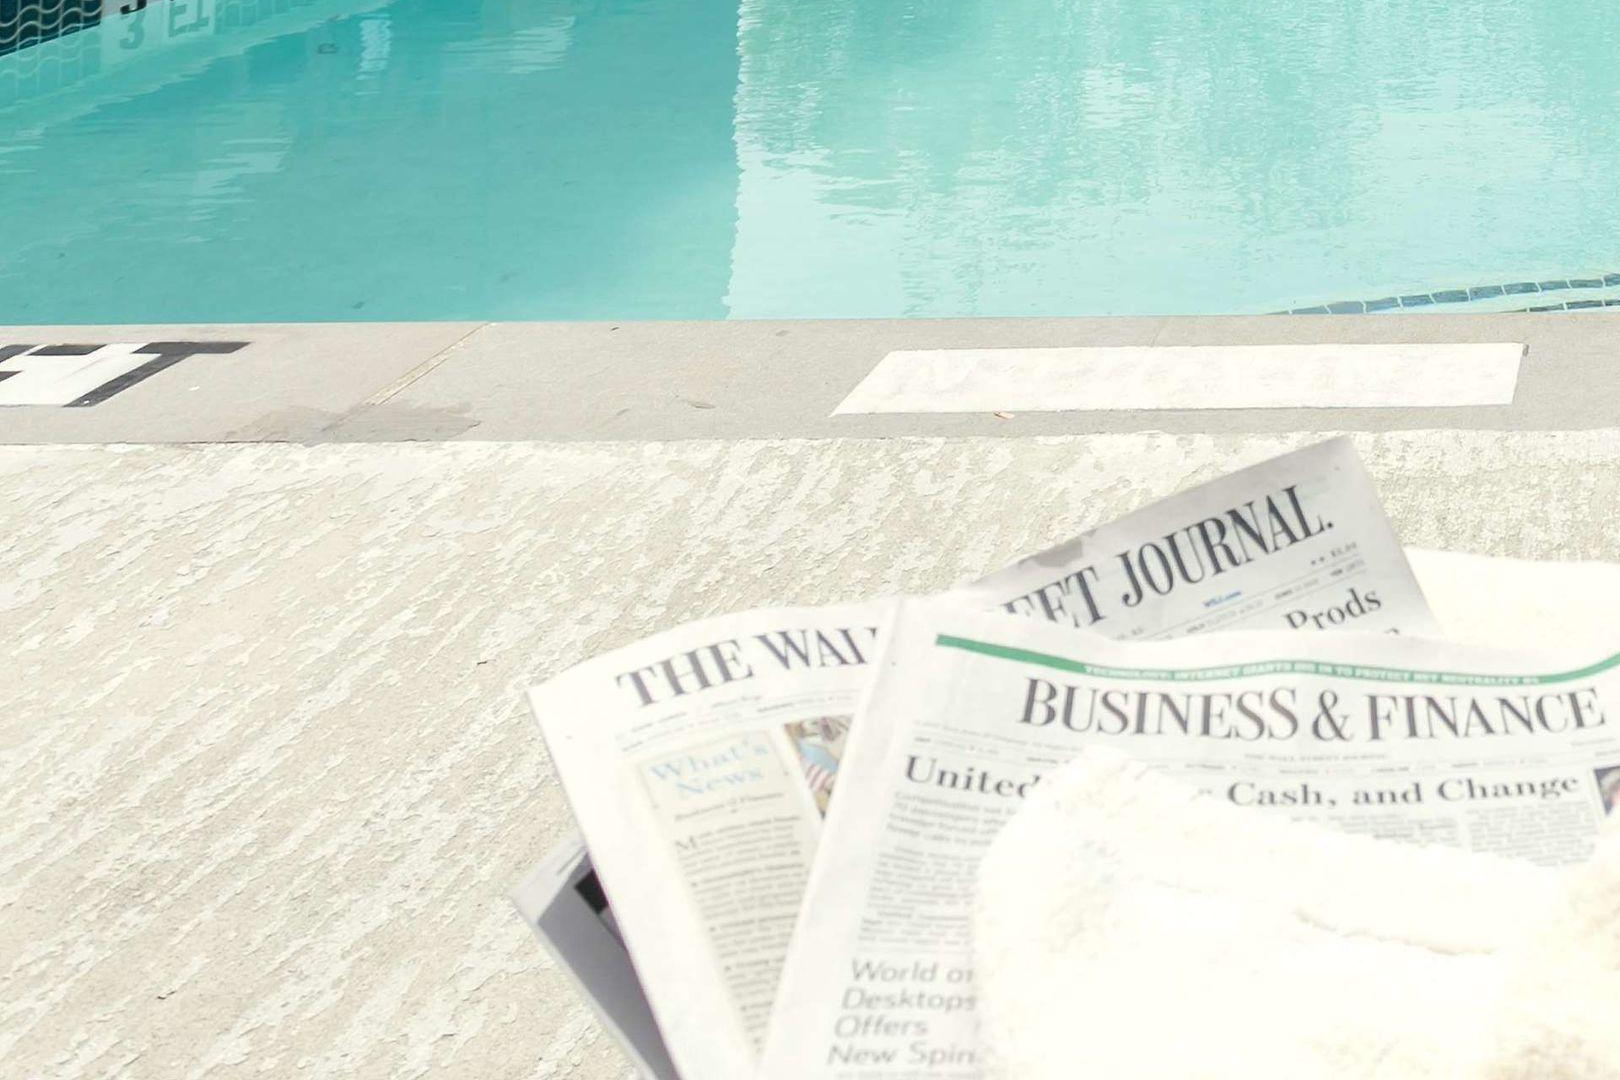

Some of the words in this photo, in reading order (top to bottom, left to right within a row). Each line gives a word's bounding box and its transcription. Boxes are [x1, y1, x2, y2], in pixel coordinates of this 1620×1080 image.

[1114, 484, 1334, 608] JOURNAL.
[615, 638, 754, 706] THE
[1020, 677, 1299, 741] BUSINESS
[1312, 688, 1353, 743] &
[1364, 686, 1606, 741] FINANCE
[1226, 781, 1339, 809] Cash,
[1351, 781, 1425, 806] and
[1436, 775, 1581, 802] Change
[851, 958, 940, 983] World
[841, 985, 978, 1013] Desktops
[833, 1014, 929, 1038] Offers
[826, 1042, 898, 1066] New
